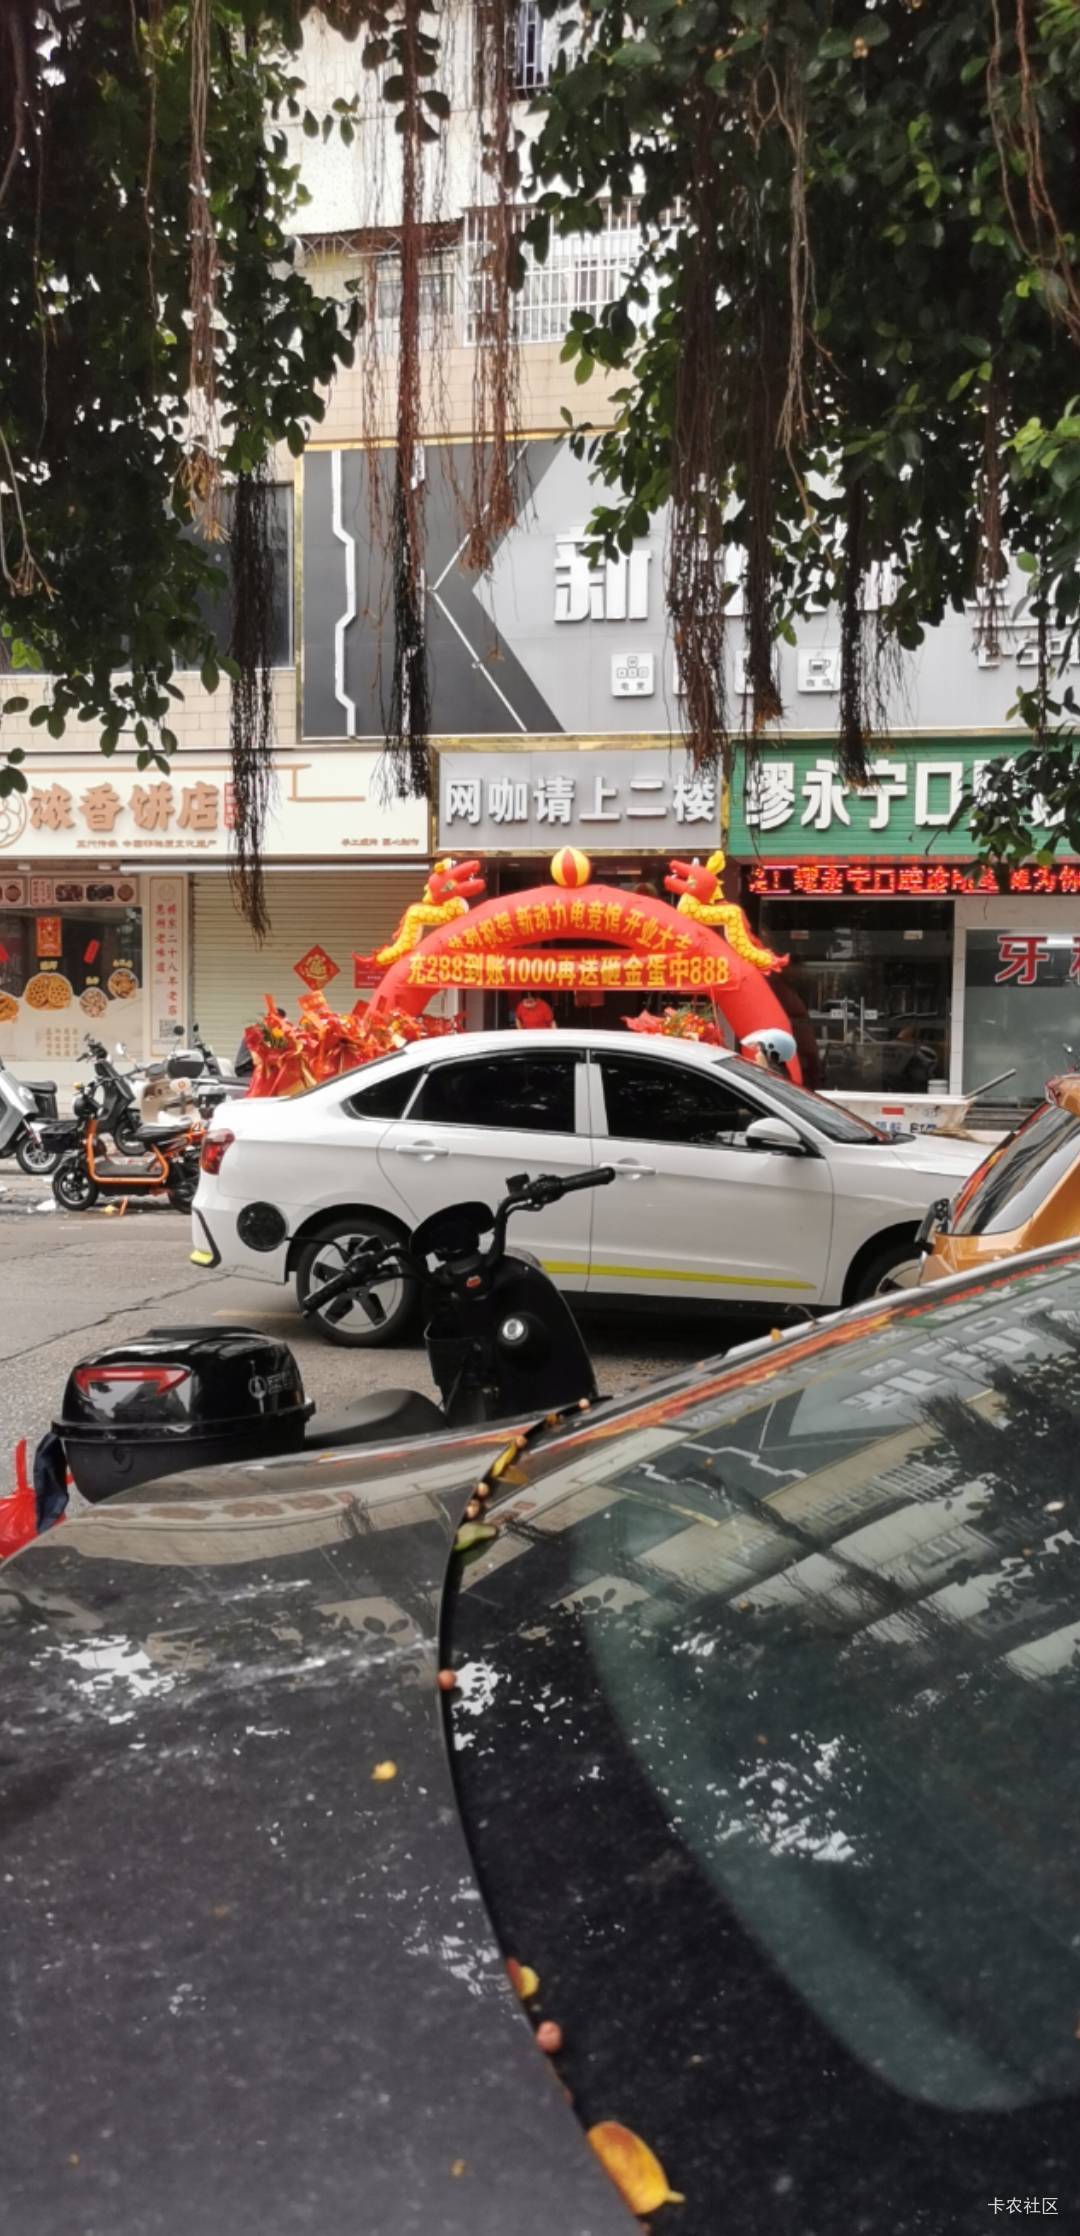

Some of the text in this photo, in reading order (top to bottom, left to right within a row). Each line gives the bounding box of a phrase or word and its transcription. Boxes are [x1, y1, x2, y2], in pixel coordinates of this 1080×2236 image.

[30, 781, 220, 832] 浓香饼店
[445, 775, 716, 824] 网咖请上二楼
